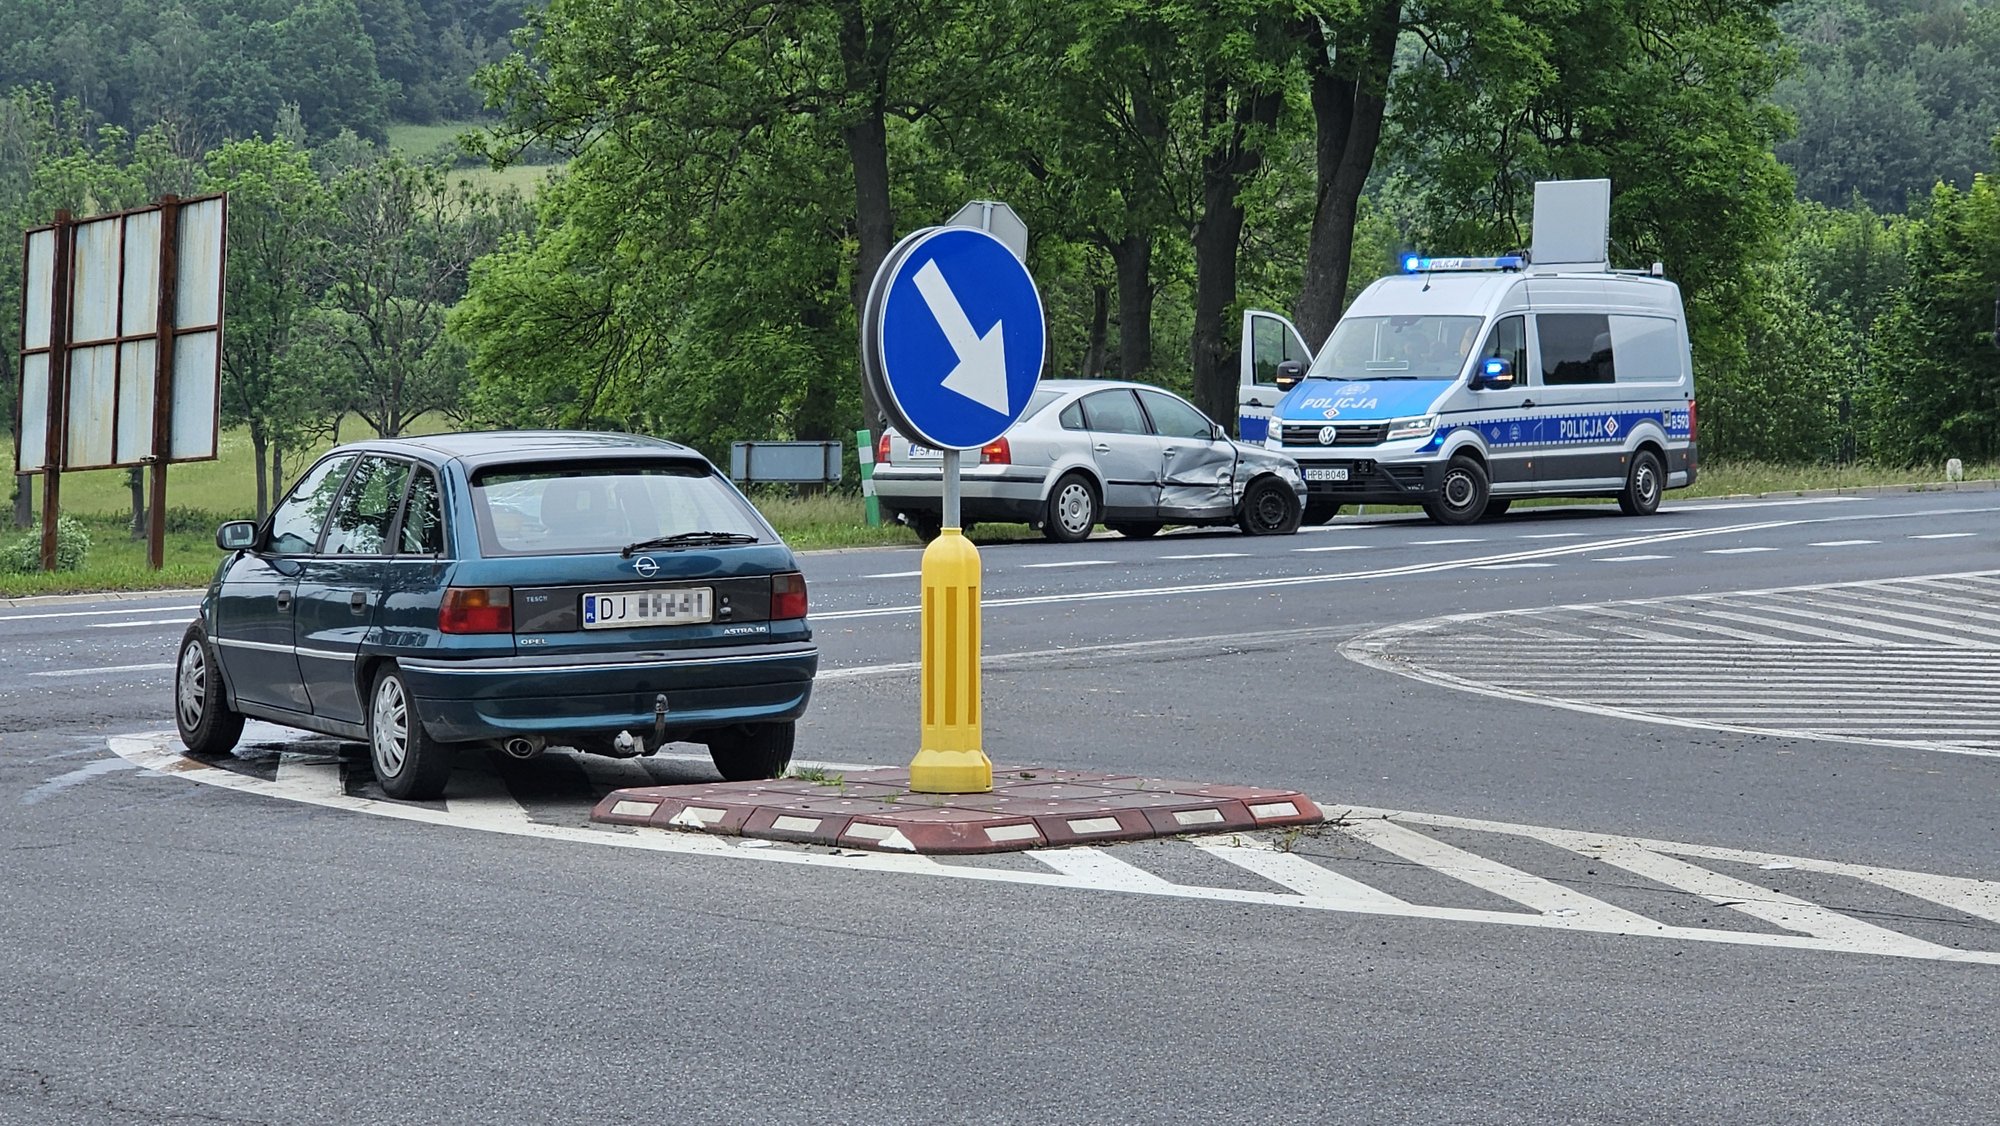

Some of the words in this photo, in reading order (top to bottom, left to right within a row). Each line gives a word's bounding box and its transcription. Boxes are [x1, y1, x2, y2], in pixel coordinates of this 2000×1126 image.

[1431, 260, 1459, 268] POLICJA
[1300, 398, 1378, 409] POLICJA
[1560, 419, 1603, 438] POLICJA
[1307, 470, 1323, 479] HPB
[1325, 470, 1346, 479] B048
[601, 597, 626, 620] DJ
[724, 627, 753, 635] ASTRA
[520, 637, 548, 645] OPEL
